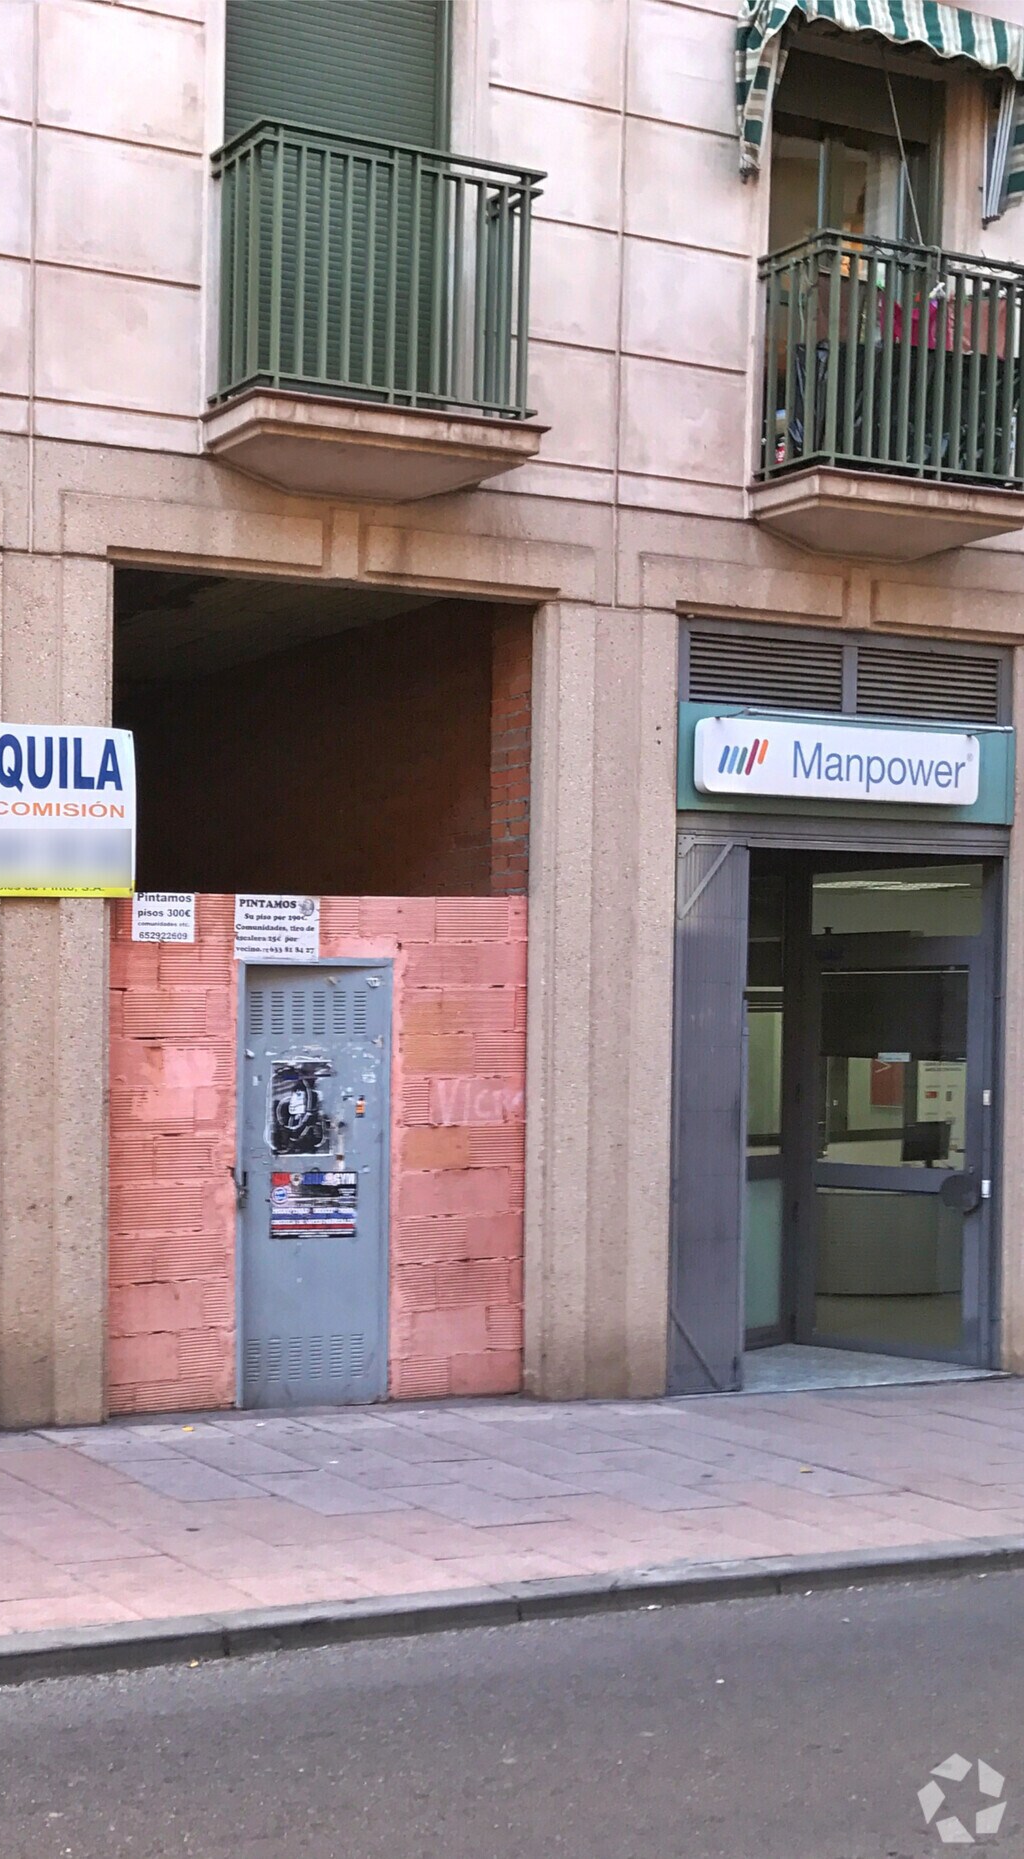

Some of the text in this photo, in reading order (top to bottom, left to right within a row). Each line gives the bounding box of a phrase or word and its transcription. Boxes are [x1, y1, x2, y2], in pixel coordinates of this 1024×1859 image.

[792, 740, 966, 793] Manpower
[137, 892, 192, 902] Pintamos
[239, 899, 297, 909] PINTAMOS
[137, 909, 191, 918] pisos 300€
[256, 913, 272, 921] piso
